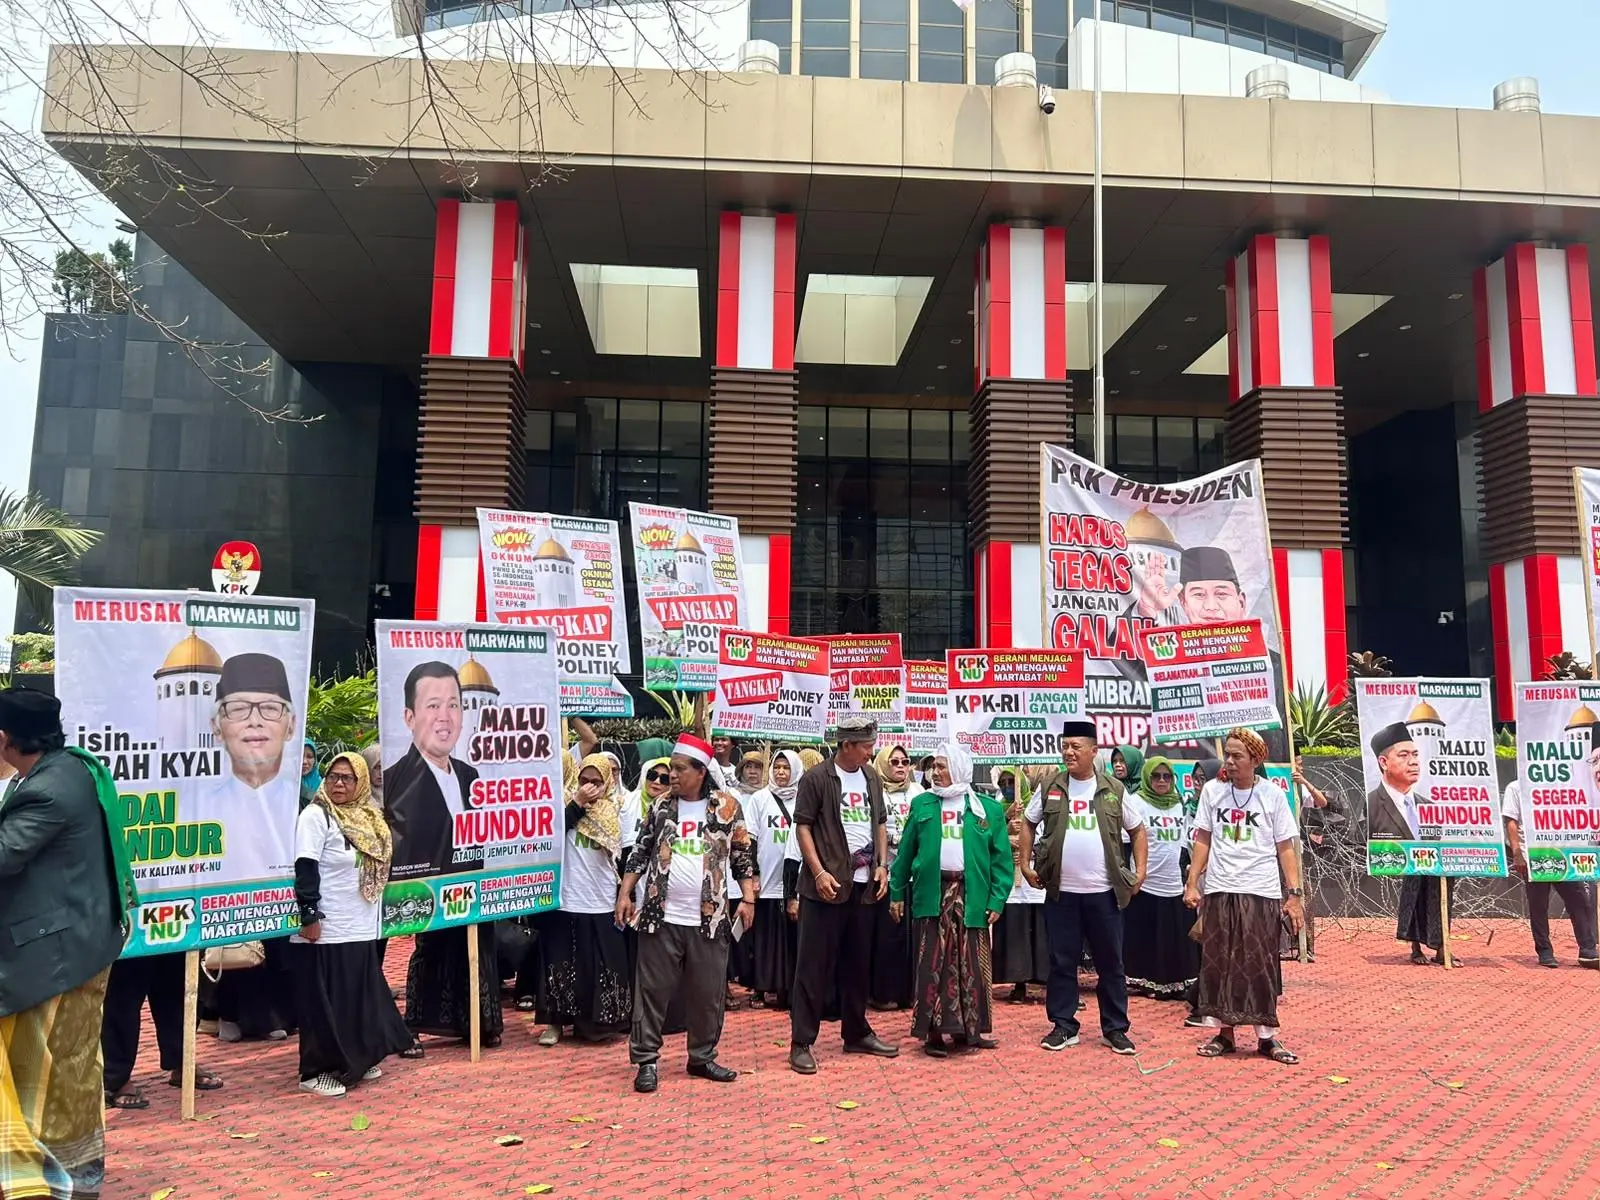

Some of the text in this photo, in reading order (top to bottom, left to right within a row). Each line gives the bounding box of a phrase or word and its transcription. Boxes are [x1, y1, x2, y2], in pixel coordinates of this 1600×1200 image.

[1051, 458, 1253, 505] PAK PRESIDEN
[553, 520, 608, 532] MARWAH NU
[720, 520, 730, 529] NU
[1050, 514, 1128, 549] HARUS
[493, 531, 535, 547] WOW!
[491, 552, 532, 563] OKNUM
[592, 561, 611, 570] TRIO
[1051, 551, 1132, 593] TEGAS
[581, 569, 612, 579] OKNUM
[220, 584, 249, 595] KPK
[583, 579, 613, 589] ISTANA
[495, 591, 535, 600] KEMBALIKAN
[1052, 595, 1119, 611] JANGAN
[74, 601, 296, 626] MERUSAK MARWAH NU
[655, 601, 733, 622] TANGKAP
[1181, 625, 1252, 639] BERANI MENJAGA
[391, 631, 545, 649] MERUSAK MARWAH NU
[727, 637, 750, 649] KPK
[757, 638, 820, 652] BERANI MENJAGA
[1149, 634, 1176, 648] KPK
[1183, 634, 1249, 647] DAN MENGAWAL
[731, 648, 746, 658] NU
[773, 649, 816, 660] MENGAWAL
[1156, 645, 1174, 657] NU
[1185, 645, 1242, 657] MARTABAT NU
[756, 656, 794, 666] MARTABAT
[832, 655, 870, 663] MARTABAT
[958, 657, 986, 669] KPK
[994, 655, 1072, 663] BERANI MENJAGA
[963, 669, 982, 679] NU
[994, 664, 1067, 672] DAN MENGAWAL
[1213, 662, 1265, 675] MARWAH NU
[851, 670, 901, 685] OKNUM
[1220, 678, 1267, 690] MENERIMA
[725, 678, 779, 700] TANGKAP
[854, 688, 900, 698] ANNASIR
[1366, 683, 1480, 696] MERUSAK MARWAH NU
[1525, 688, 1577, 700] MERUSAK
[780, 689, 824, 704] MONEY
[1029, 693, 1077, 702] JANGAN
[1207, 688, 1268, 705] UANG RISYWAH
[768, 703, 812, 717] POLITIK
[861, 699, 892, 709] JAHAT
[956, 694, 1019, 713] KPK-RI
[1029, 703, 1078, 714] GALAU
[480, 707, 545, 732] MALU
[719, 711, 753, 721] DIRUMAH
[1158, 713, 1195, 725] DIRUMAH
[718, 720, 752, 729] PUSAKA
[995, 720, 1042, 728] SEGERA
[1159, 722, 1197, 733] PUSAKA
[956, 731, 1005, 744] Tangkap
[471, 735, 551, 762] SENIOR
[979, 744, 1006, 755] Adili
[1438, 739, 1485, 757] MALU
[1526, 742, 1583, 761] MALU
[161, 750, 221, 778] KYAI
[1429, 761, 1490, 776] SENIOR
[1528, 763, 1571, 782] GUS
[472, 776, 552, 805] SEGERA
[1431, 786, 1489, 801] SEGERA
[1532, 790, 1587, 805] SEGERA
[1150, 815, 1184, 828] KPK
[1217, 808, 1260, 828] KPK
[1419, 805, 1492, 825] MUNDUR
[455, 806, 552, 846] MUNDUR
[1066, 816, 1096, 830] NU
[1157, 828, 1181, 841] NU
[1445, 828, 1468, 836] JEMPUT
[1470, 829, 1494, 837] KPK-NU
[453, 842, 552, 863] ATAU DI JEMPUT KPK-NU
[1412, 849, 1436, 859] KPK
[1441, 848, 1498, 856] BERANI MENJAGA
[1416, 859, 1433, 868] NU
[1572, 855, 1595, 865] KPK
[149, 861, 221, 878] KALIYAN KPK-NU
[1577, 864, 1592, 873] NU
[480, 871, 554, 890] BERANI MENJAGA
[443, 886, 473, 903] KPK
[480, 885, 552, 903] DAN MENGAWAL
[202, 893, 249, 909] BERANI
[480, 895, 552, 916] MARTABAT NU
[142, 903, 190, 925] KPK
[447, 901, 467, 916] NU
[201, 911, 230, 925] DAN
[150, 922, 183, 940] NU
[201, 918, 283, 940] MARTABAT
